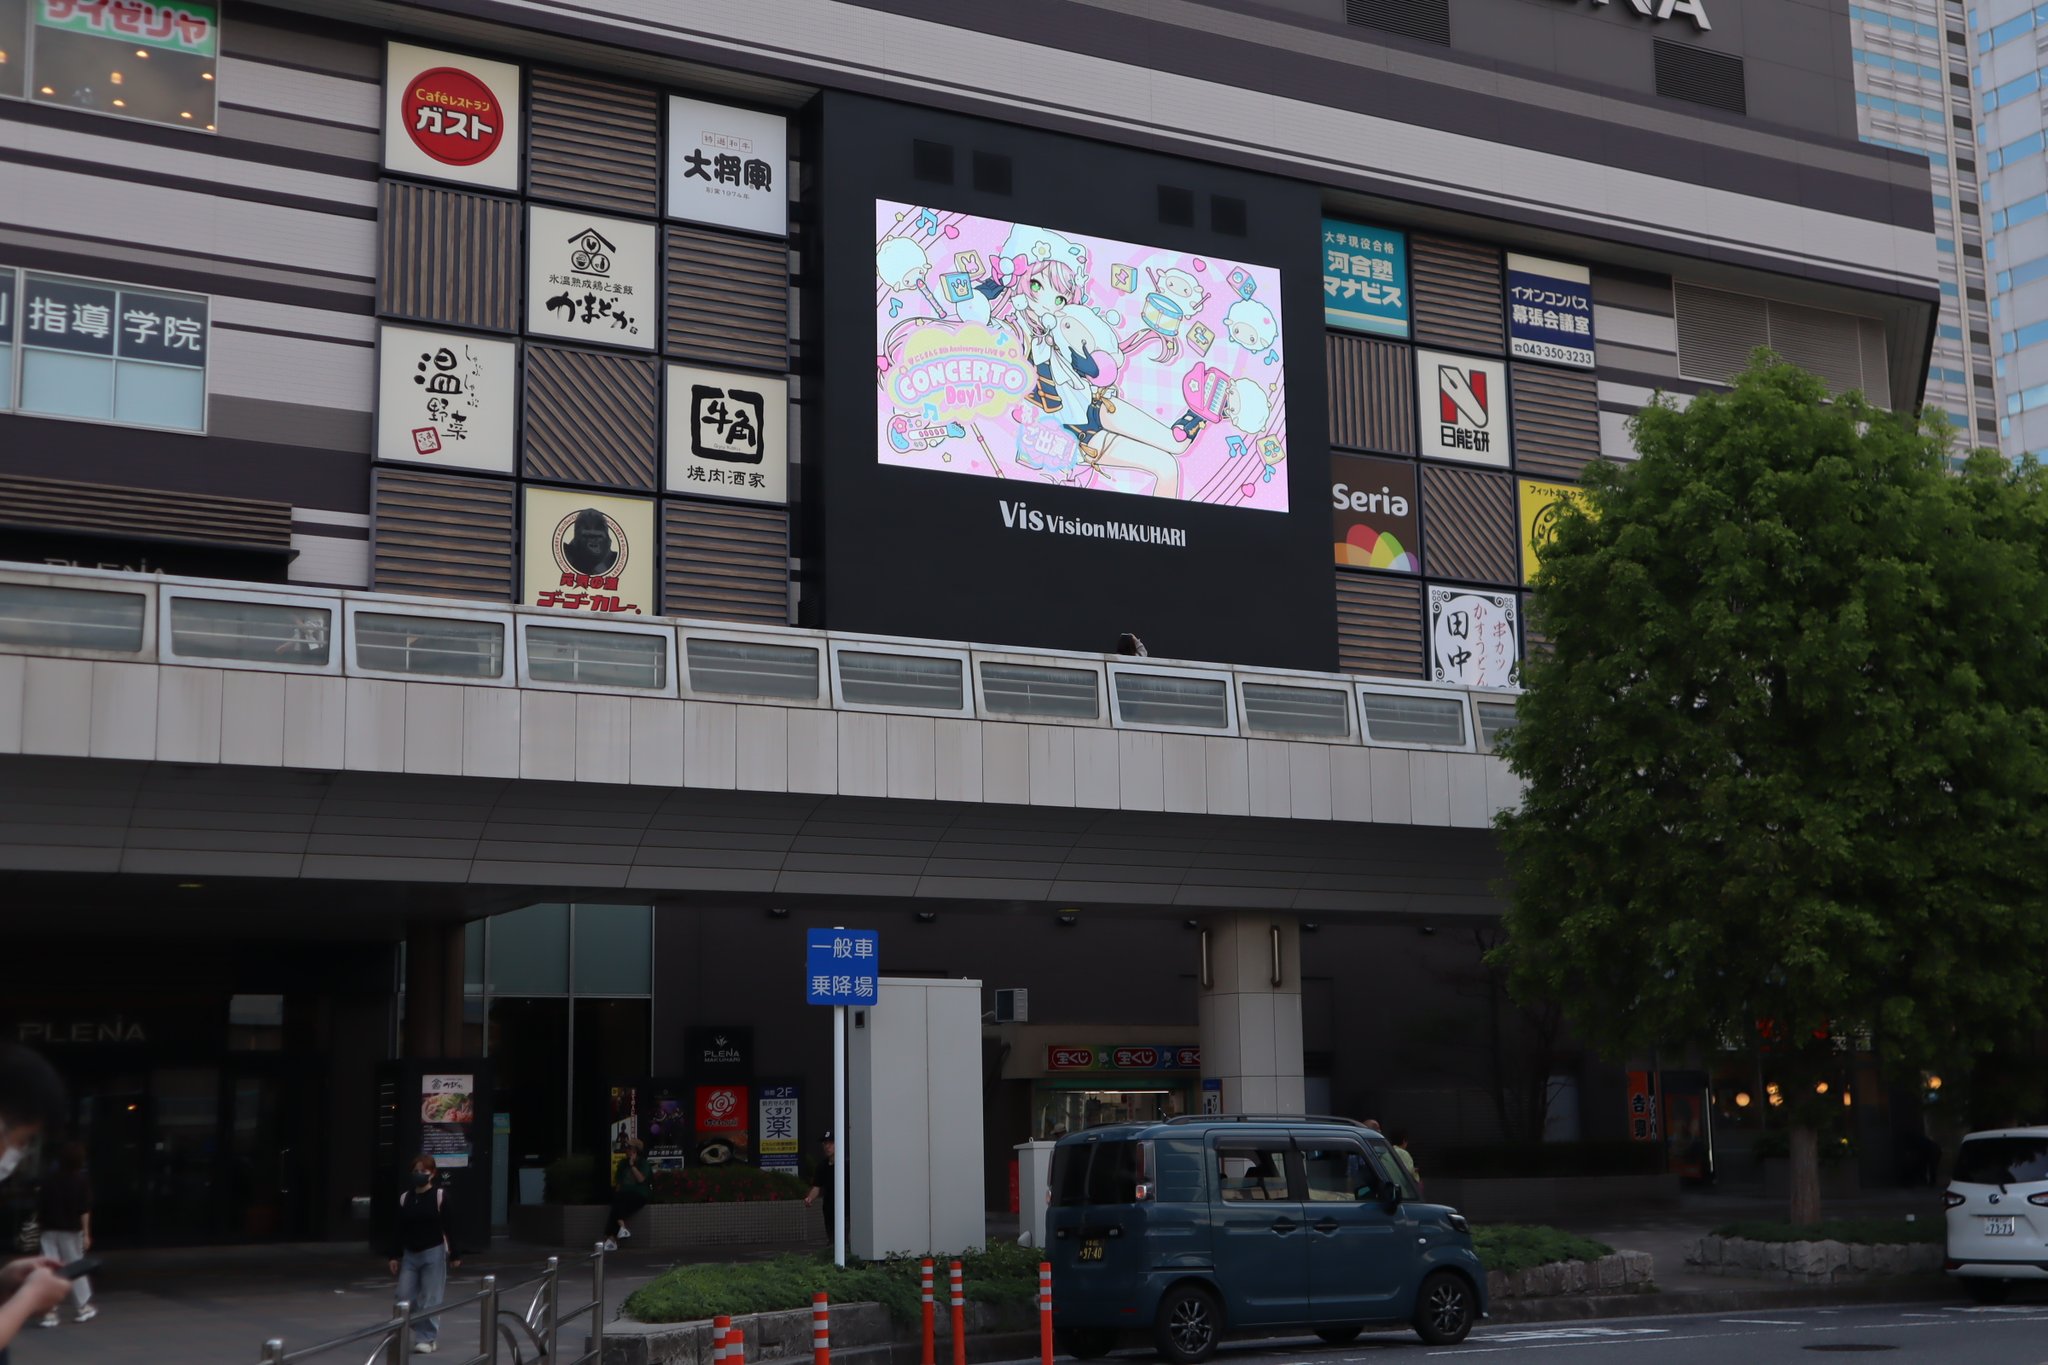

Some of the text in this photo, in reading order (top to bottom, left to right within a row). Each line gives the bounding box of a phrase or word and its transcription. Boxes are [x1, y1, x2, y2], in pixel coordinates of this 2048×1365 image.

[46, 0, 208, 45] サイゼリヤ
[416, 106, 493, 141] ガスト
[684, 148, 772, 192] 大将軍
[1324, 231, 1395, 255] 大学現役合格
[1327, 249, 1394, 282] 河合塾
[549, 274, 634, 295] 氷温熟成鶏と釜飯
[1324, 276, 1402, 308] マナビス
[1511, 286, 1589, 311] イオンコンパス
[0, 293, 201, 351] 指導学院
[546, 290, 635, 330] かまどか
[1512, 304, 1590, 335] 幕張会議室
[1522, 343, 1592, 365] 043-350-3233
[413, 347, 468, 440] 温野菜
[899, 359, 1024, 400] CONCERTO
[702, 399, 757, 447] 牛角
[1441, 425, 1490, 452] 日能研
[687, 465, 766, 489] 焼肉酒家
[999, 499, 1044, 531] Vis
[1332, 483, 1409, 517] Seria
[1446, 610, 1472, 678] 田中
[811, 937, 874, 960] 一般車
[811, 975, 874, 998] 乗降場
[1056, 1051, 1089, 1065] 宝くじ
[1118, 1051, 1154, 1066] 宝くじ
[776, 1087, 793, 1098] 2F
[766, 1115, 792, 1138] 薬
